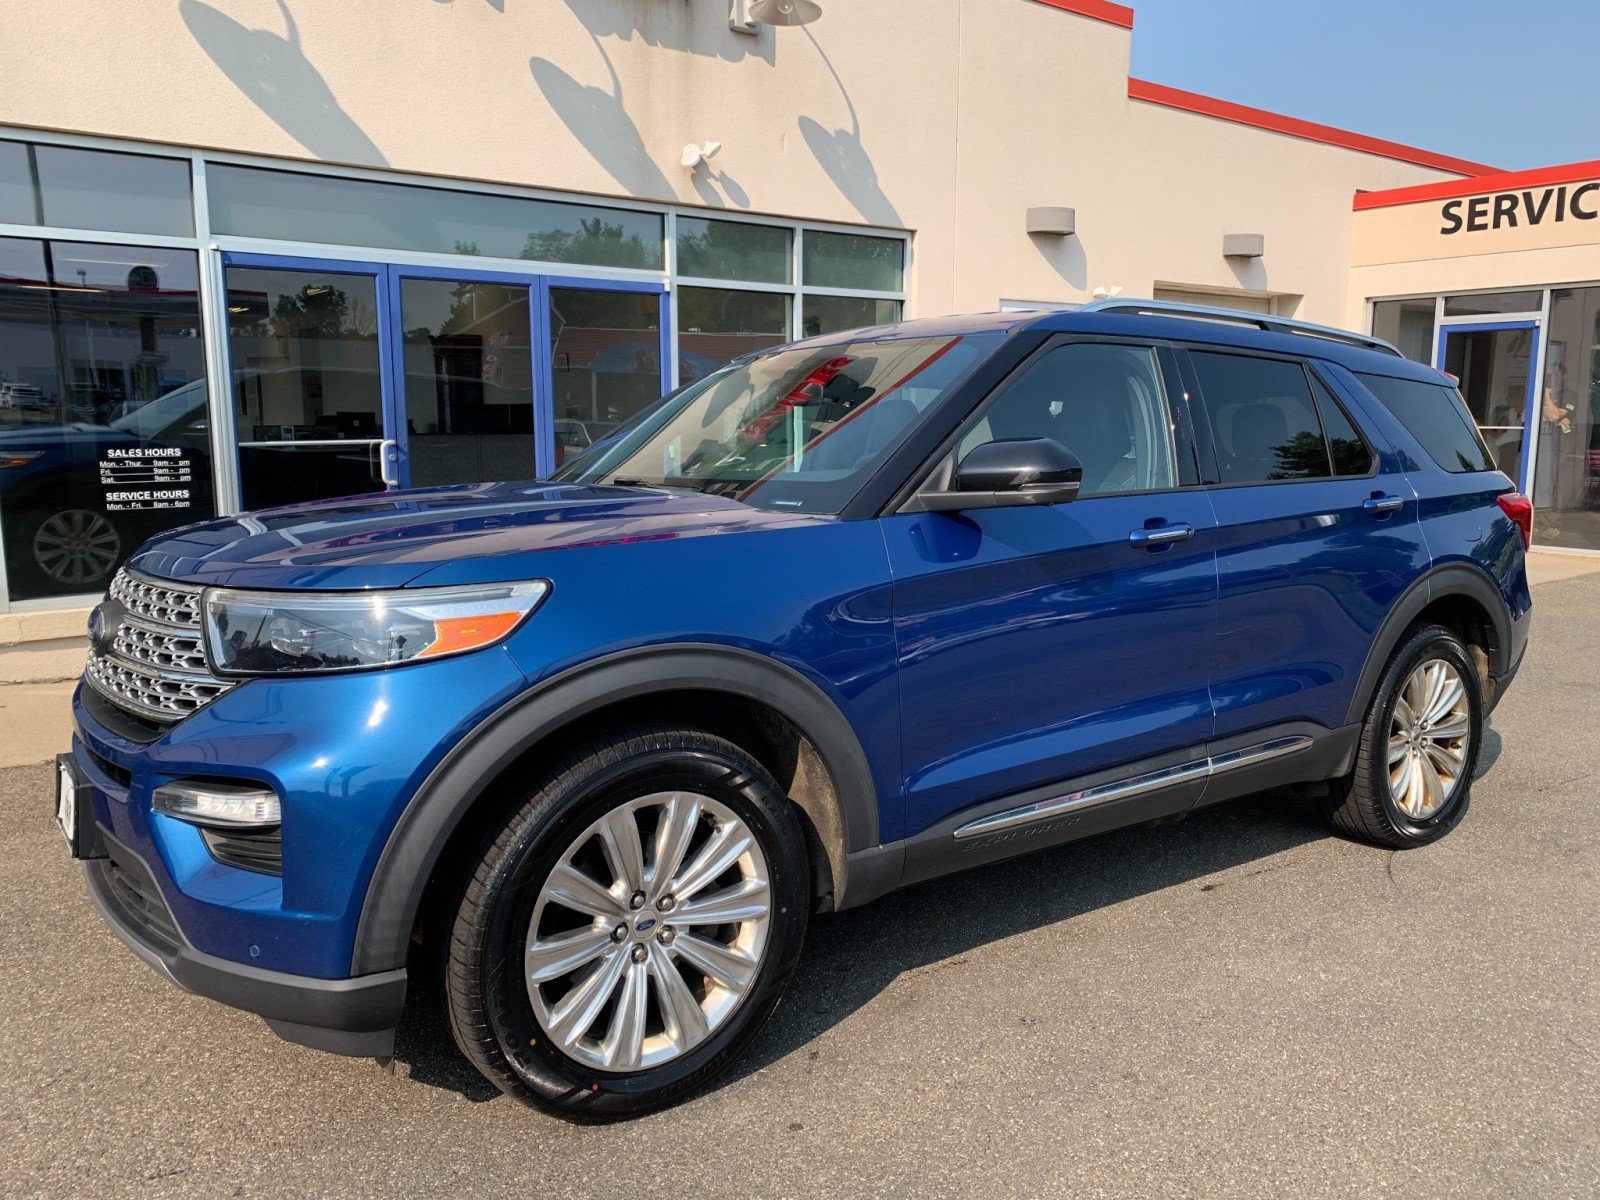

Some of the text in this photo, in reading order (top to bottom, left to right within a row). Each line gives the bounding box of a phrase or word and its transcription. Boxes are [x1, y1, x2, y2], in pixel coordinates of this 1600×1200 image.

[1440, 183, 1600, 235] SERVIC
[107, 448, 181, 457] SALES HOURS
[106, 490, 189, 501] SERVICE HOURS
